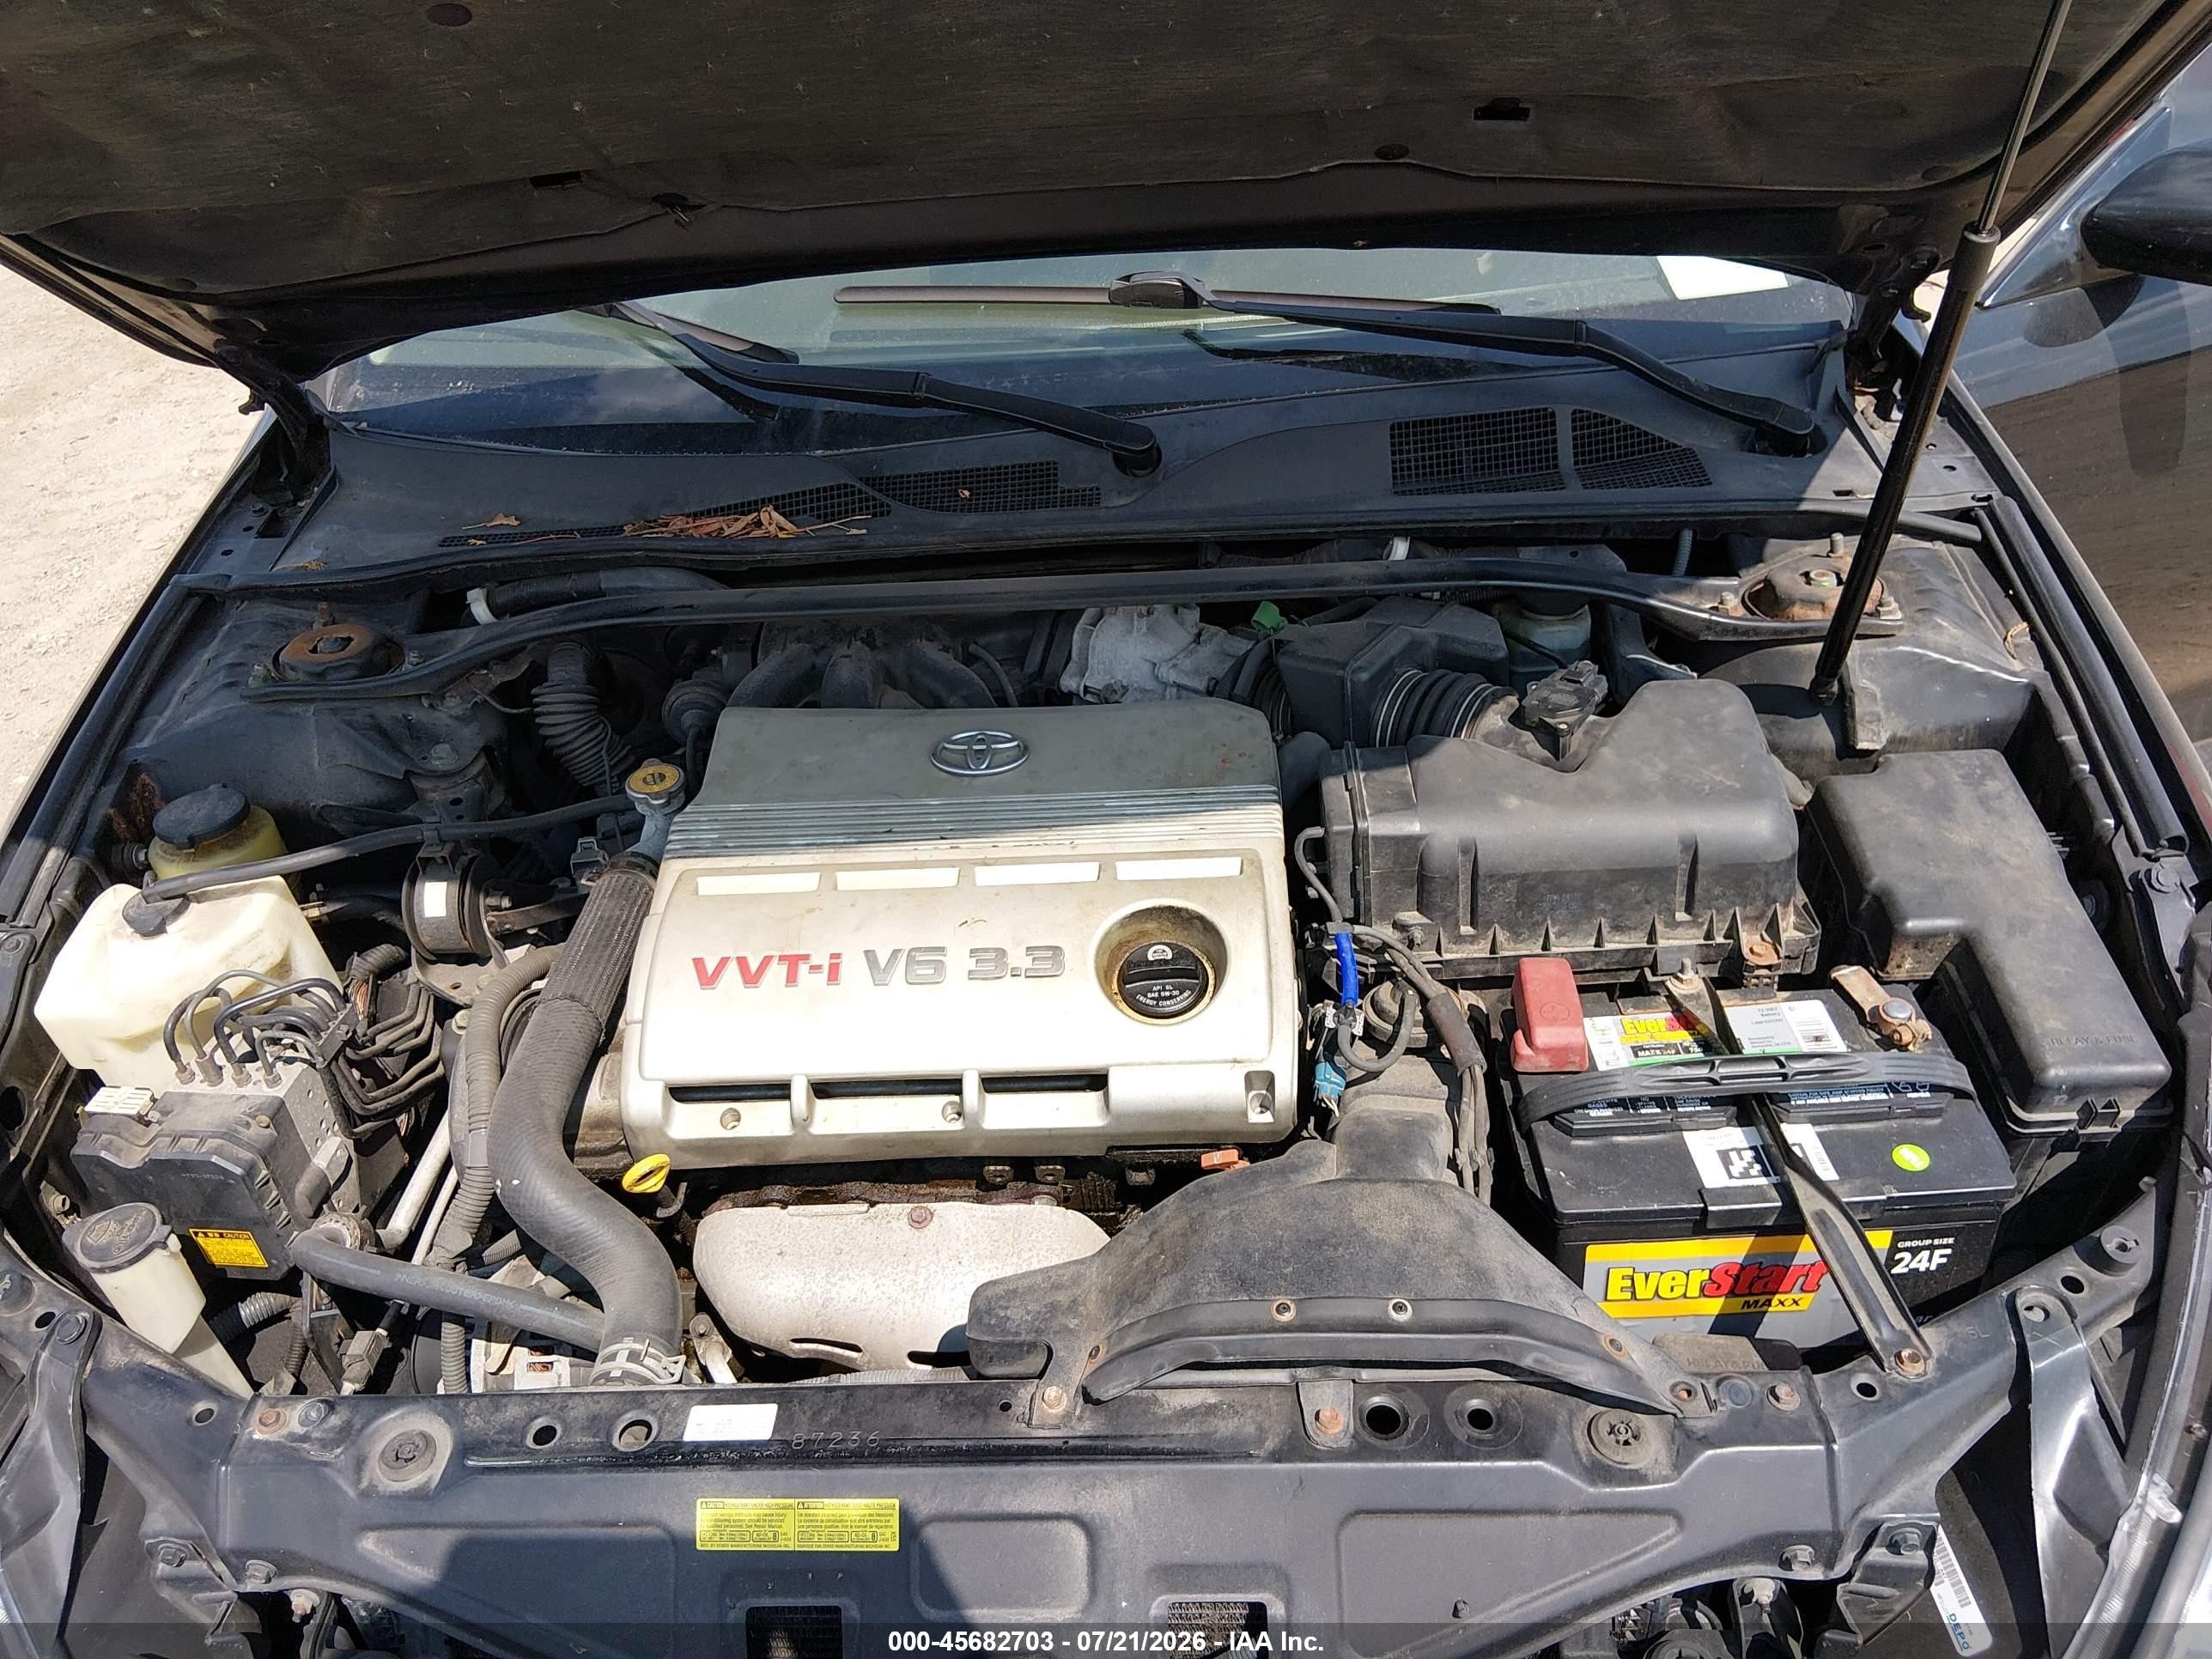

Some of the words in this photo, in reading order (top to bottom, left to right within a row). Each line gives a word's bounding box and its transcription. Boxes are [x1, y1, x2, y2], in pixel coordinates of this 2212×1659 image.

[691, 952, 843, 990] VVT-i
[862, 946, 948, 987] V6
[968, 945, 1066, 981] 3.3
[1136, 994, 1158, 1006] ENERGY
[1158, 989, 1192, 1006] CONSERVING
[1897, 1238, 1933, 1249] GROUP
[1890, 1248, 1953, 1274] 24F
[1606, 1260, 1828, 1302] EverStart
[1741, 1297, 1803, 1310] MAXX
[792, 1430, 880, 1450] 87236
[1948, 1613, 1970, 1650] DEPO
